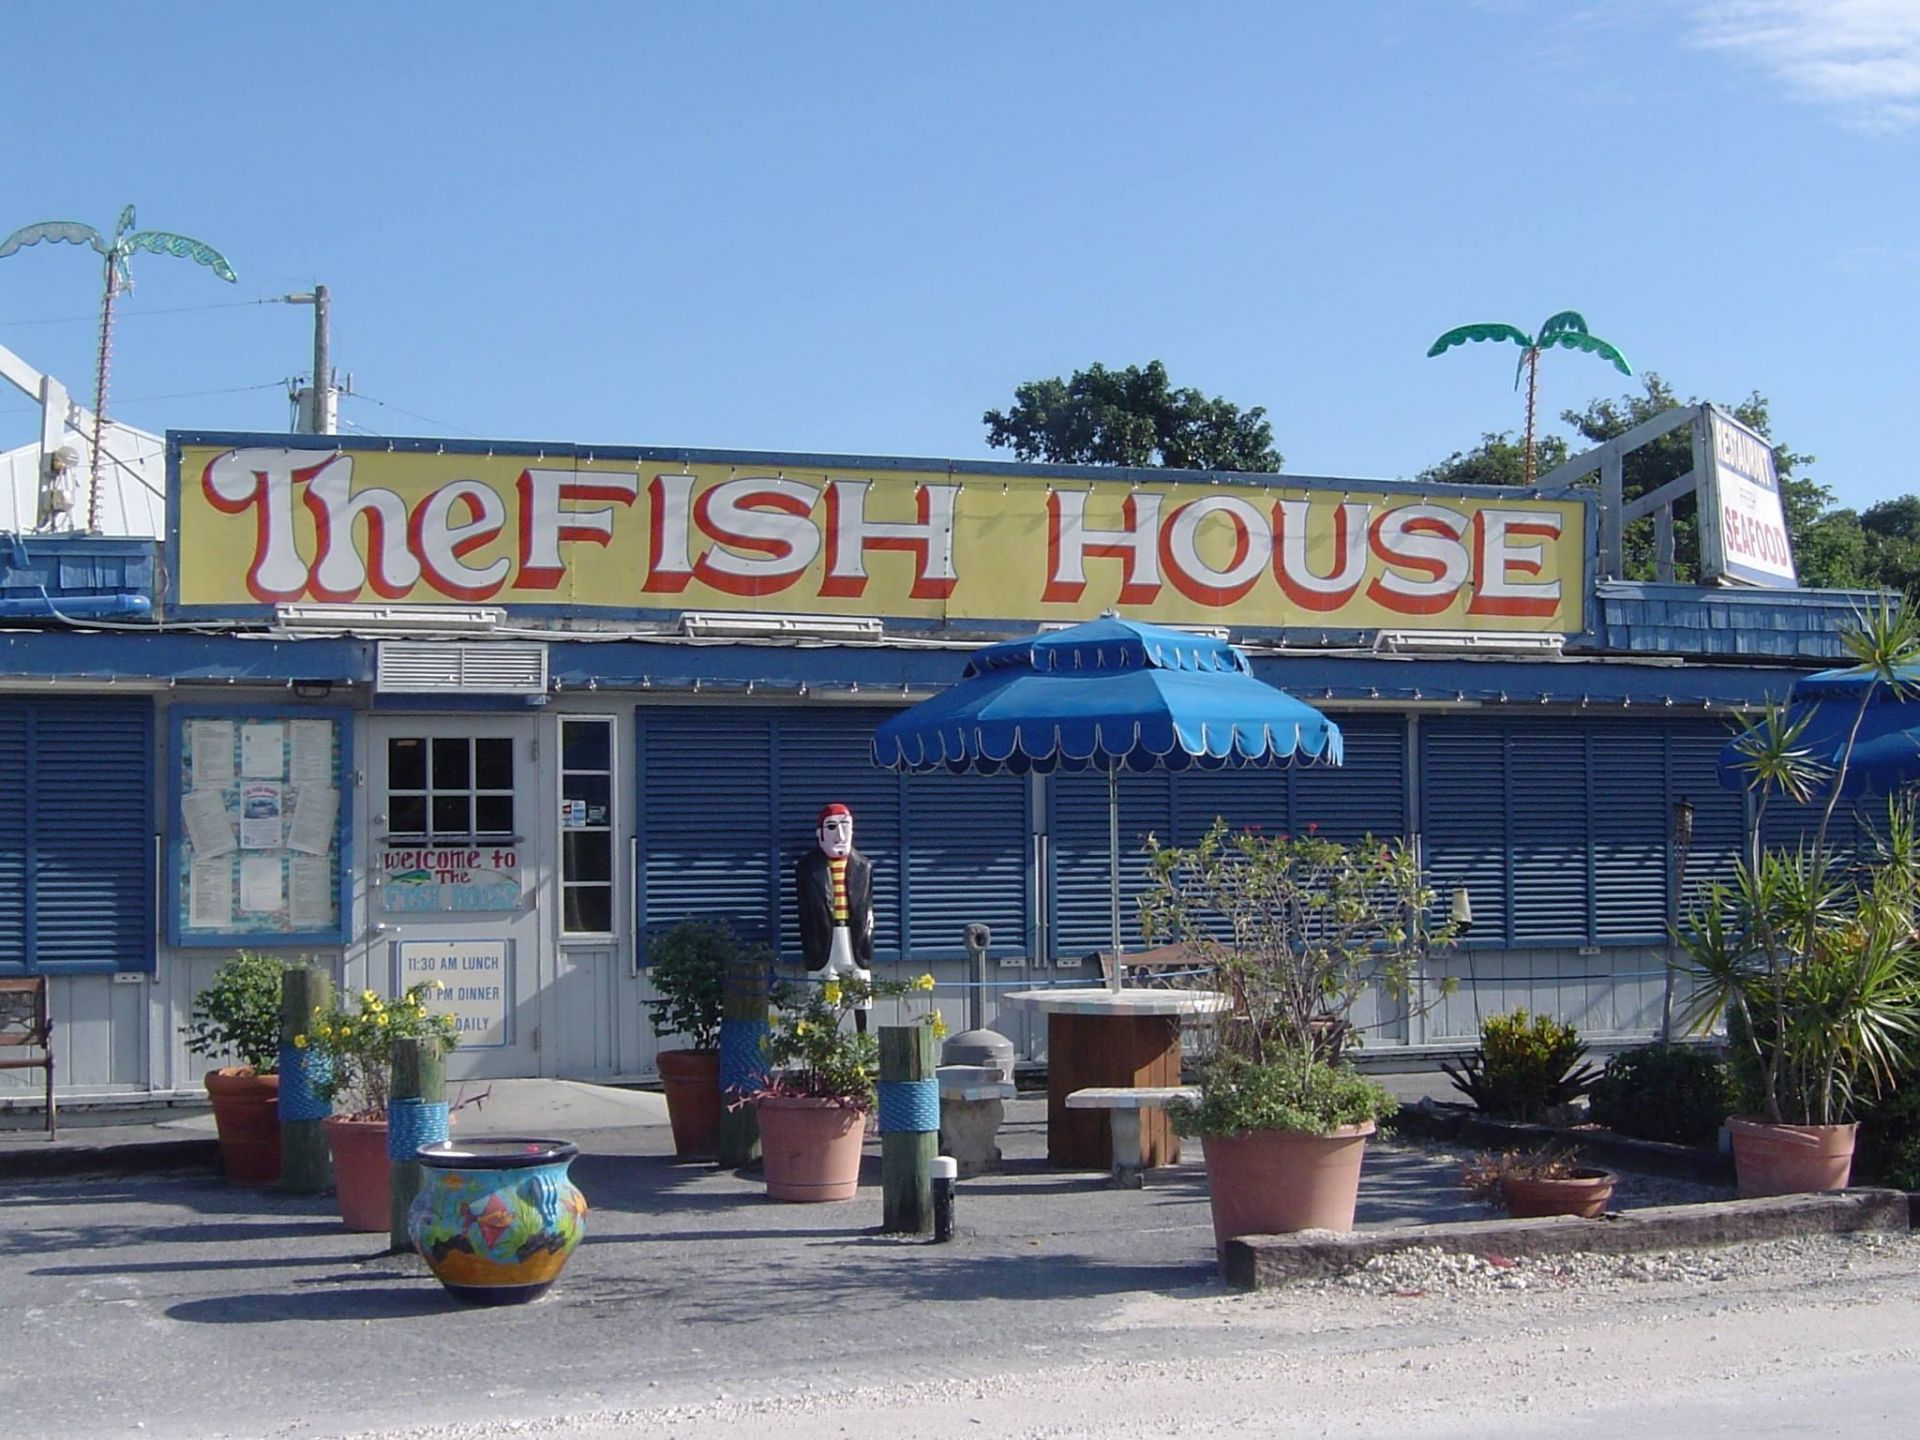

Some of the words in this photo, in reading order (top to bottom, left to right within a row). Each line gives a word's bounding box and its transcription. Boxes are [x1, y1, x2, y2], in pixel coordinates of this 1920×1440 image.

[202, 447, 510, 602] The
[511, 468, 960, 600] FISH
[1041, 489, 1563, 616] HOUSE
[1725, 505, 1787, 567] SEAFOOD
[492, 850, 516, 868] to
[435, 870, 471, 884] The
[408, 957, 435, 971] 11:30
[440, 957, 457, 970] AM
[462, 956, 498, 970] LUNCH
[437, 987, 453, 1001] PM
[458, 986, 500, 1001] DINNER
[455, 1017, 489, 1031] DAILY
